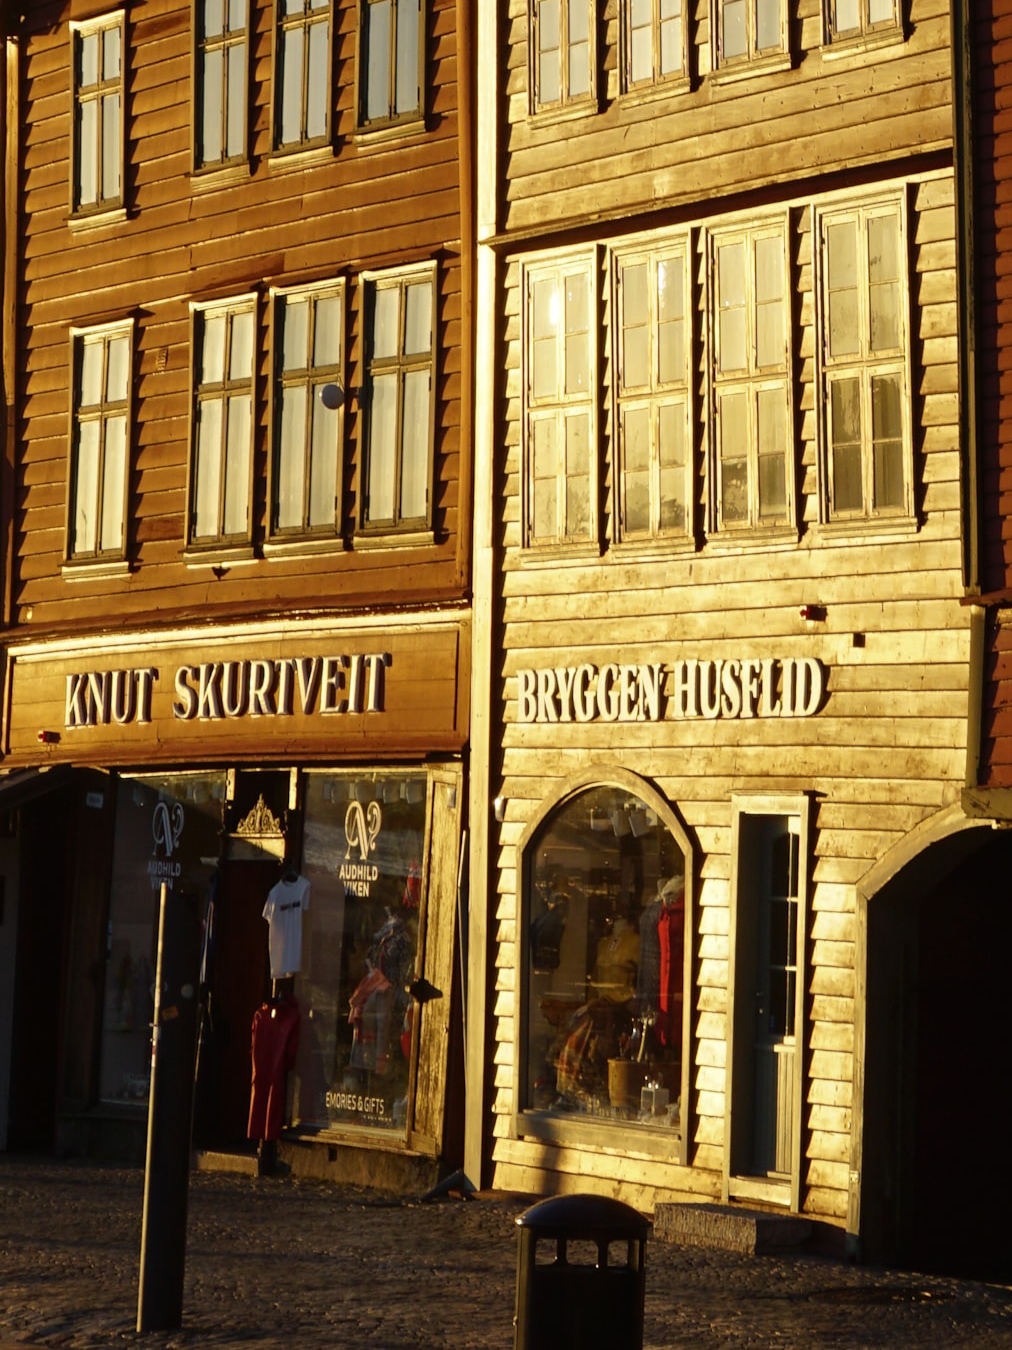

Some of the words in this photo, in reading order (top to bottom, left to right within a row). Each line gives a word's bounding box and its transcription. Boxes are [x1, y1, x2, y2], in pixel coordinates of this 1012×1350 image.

[64, 667, 157, 727] KNUT
[173, 653, 391, 720] SKURTVEIT
[516, 663, 664, 722] BRYGGEN
[672, 657, 825, 719] HUSFLID
[147, 861, 181, 877] AUDHILD
[339, 863, 378, 881] AUDHILD
[343, 880, 370, 897] VIKEN
[357, 1096, 363, 1112] &
[364, 1097, 384, 1115] GIFTS
